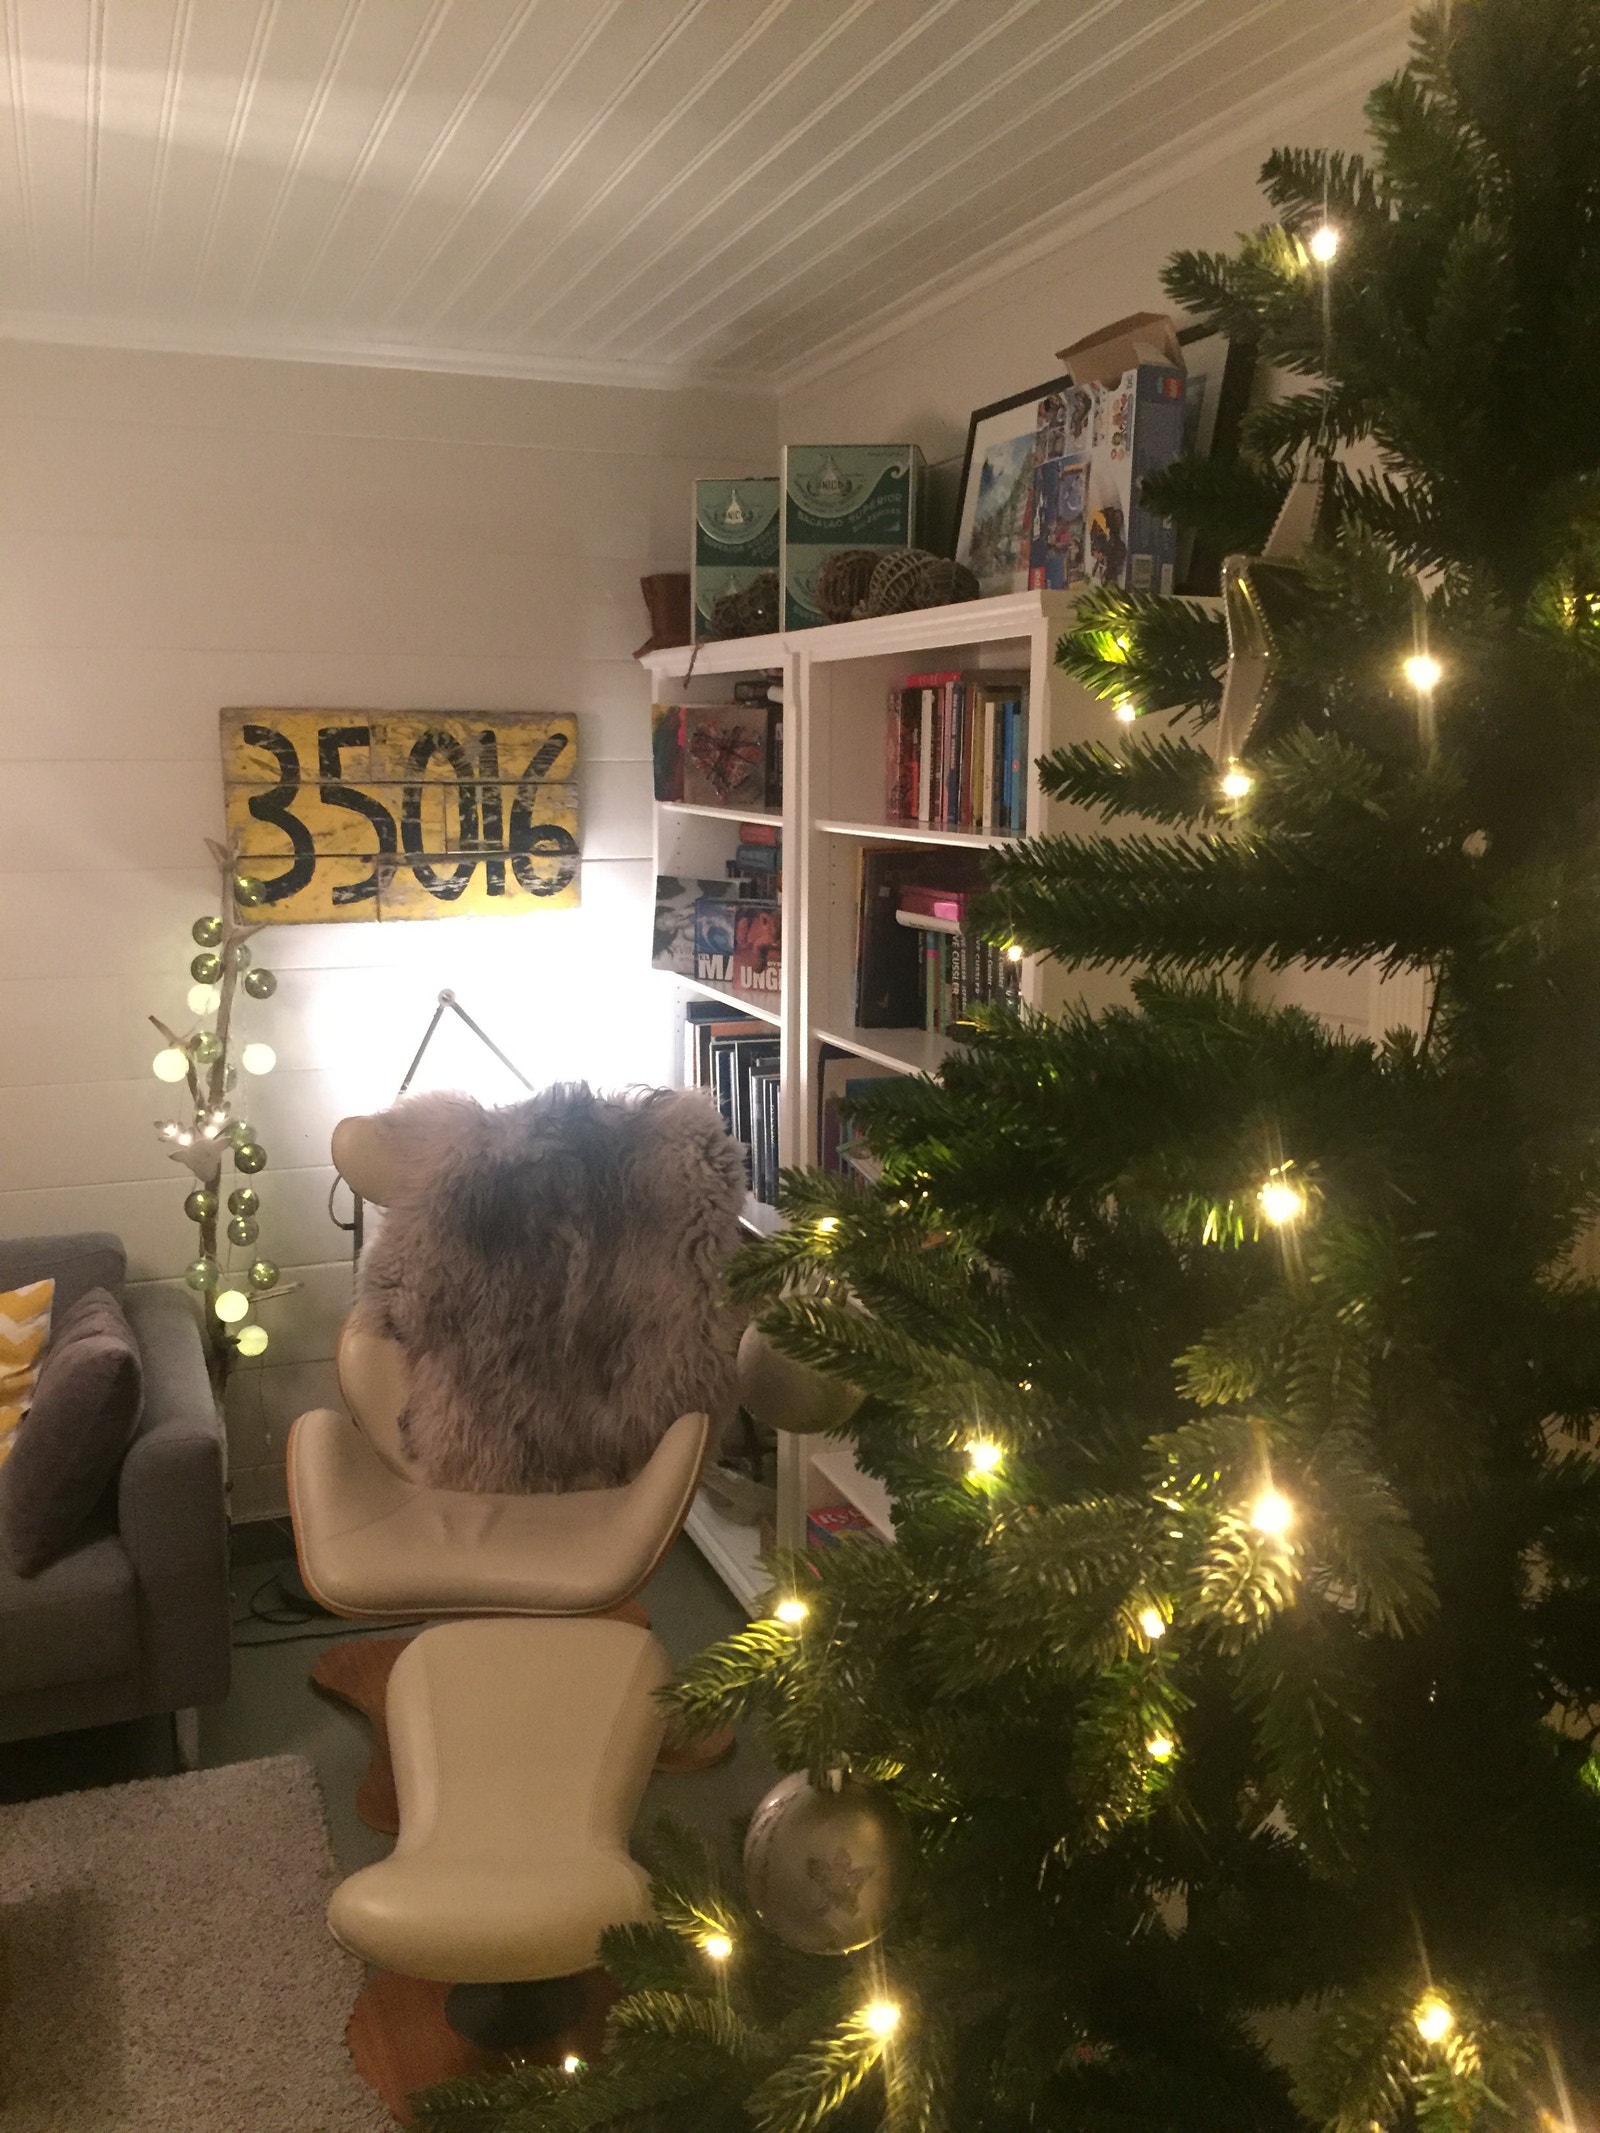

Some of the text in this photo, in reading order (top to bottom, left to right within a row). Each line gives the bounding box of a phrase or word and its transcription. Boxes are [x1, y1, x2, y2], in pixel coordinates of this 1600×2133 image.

[241, 725, 578, 906] 35016
[740, 965, 781, 991] UNG
[950, 949, 961, 995] CUSSLER
